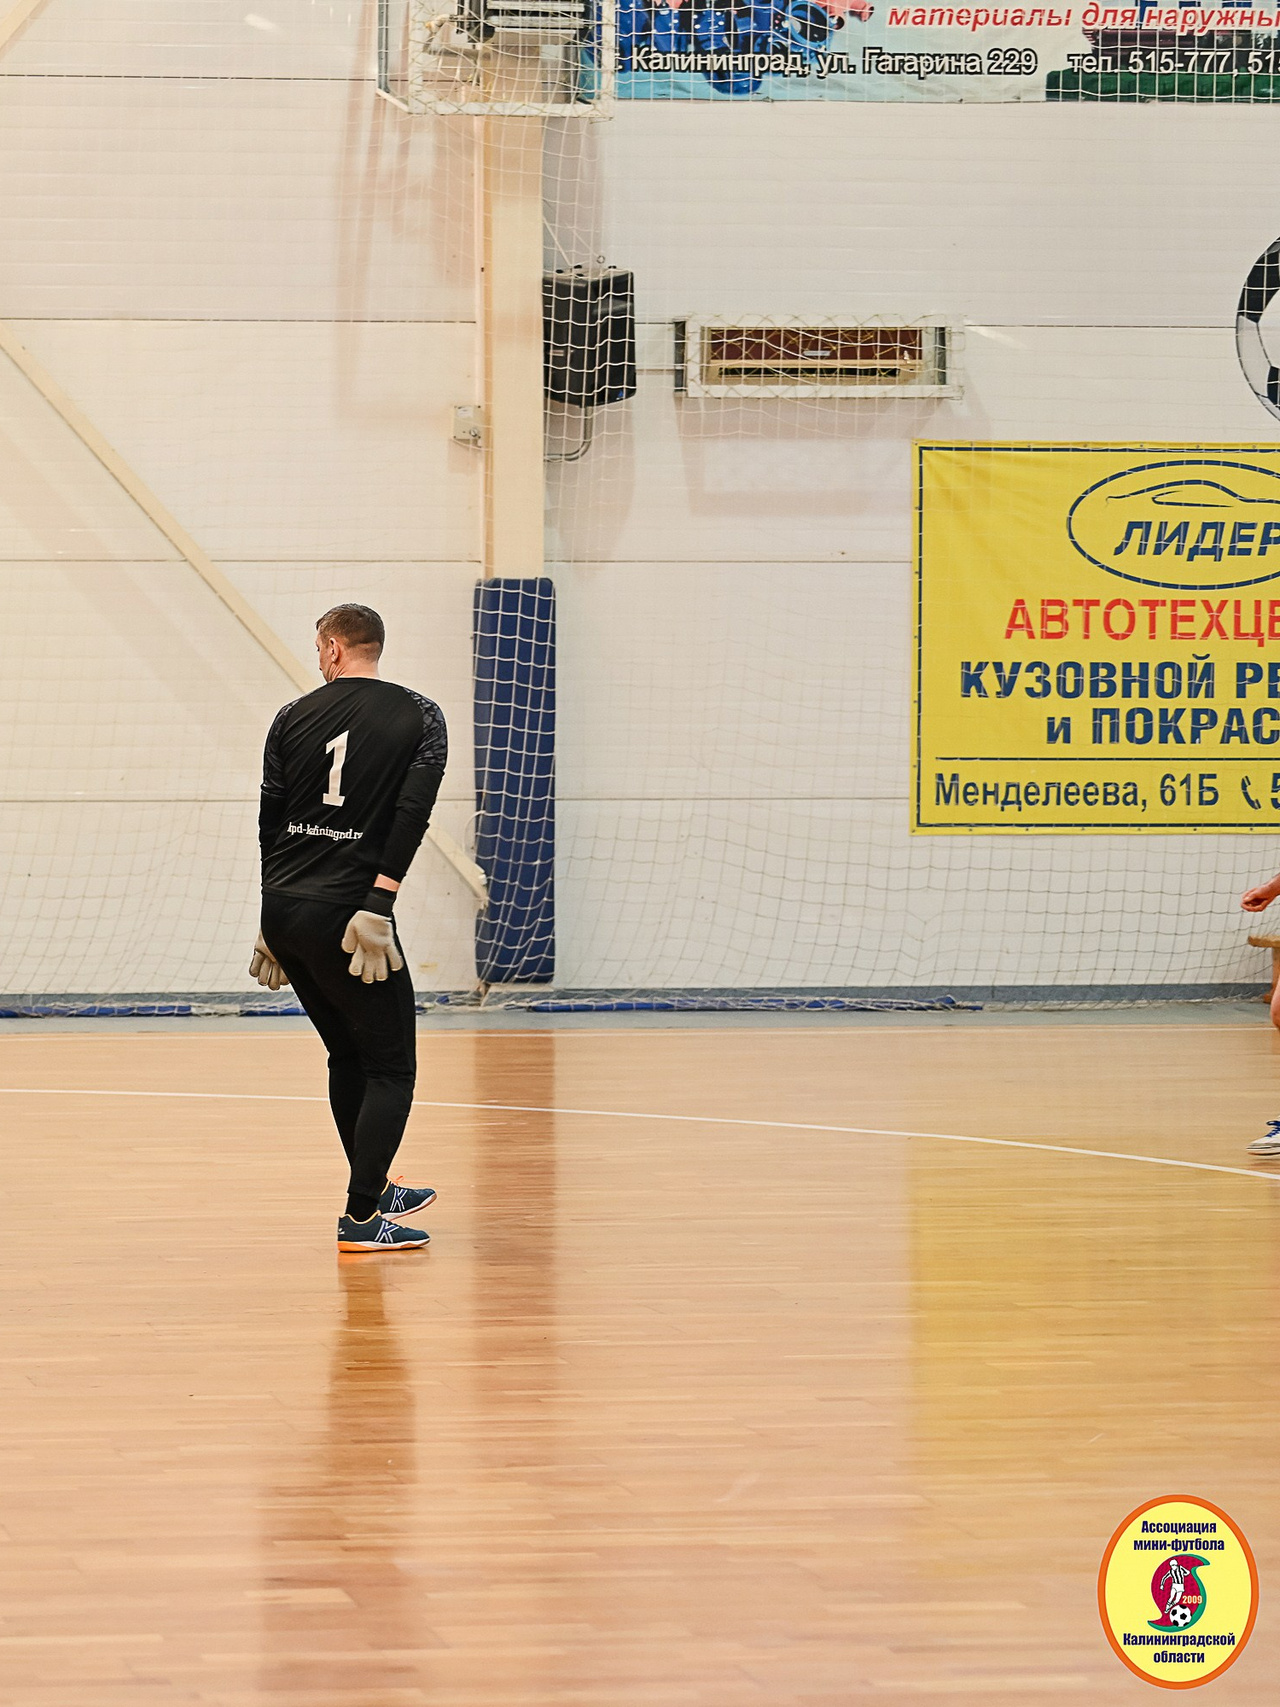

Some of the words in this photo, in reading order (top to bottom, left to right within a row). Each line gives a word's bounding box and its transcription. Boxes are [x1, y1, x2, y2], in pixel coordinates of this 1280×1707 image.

[888, 6, 1073, 32] материалы
[1081, 3, 1136, 27] для
[632, 47, 811, 76] Калининград,
[818, 54, 855, 78] ул.
[863, 49, 982, 77] Гагарина
[987, 49, 1038, 74] 229
[1068, 54, 1119, 74] тел.
[1128, 51, 1239, 77] 515-777,
[1247, 51, 1280, 74] 51
[1113, 521, 1280, 562] ЛИДЕР
[960, 654, 1215, 698] КУЗОВНОЙ
[1047, 716, 1071, 744] и
[1092, 708, 1280, 744] ПОКРАС
[322, 730, 349, 807] 1
[935, 772, 1147, 812] Менделеева,
[1160, 773, 1219, 806] 61Б
